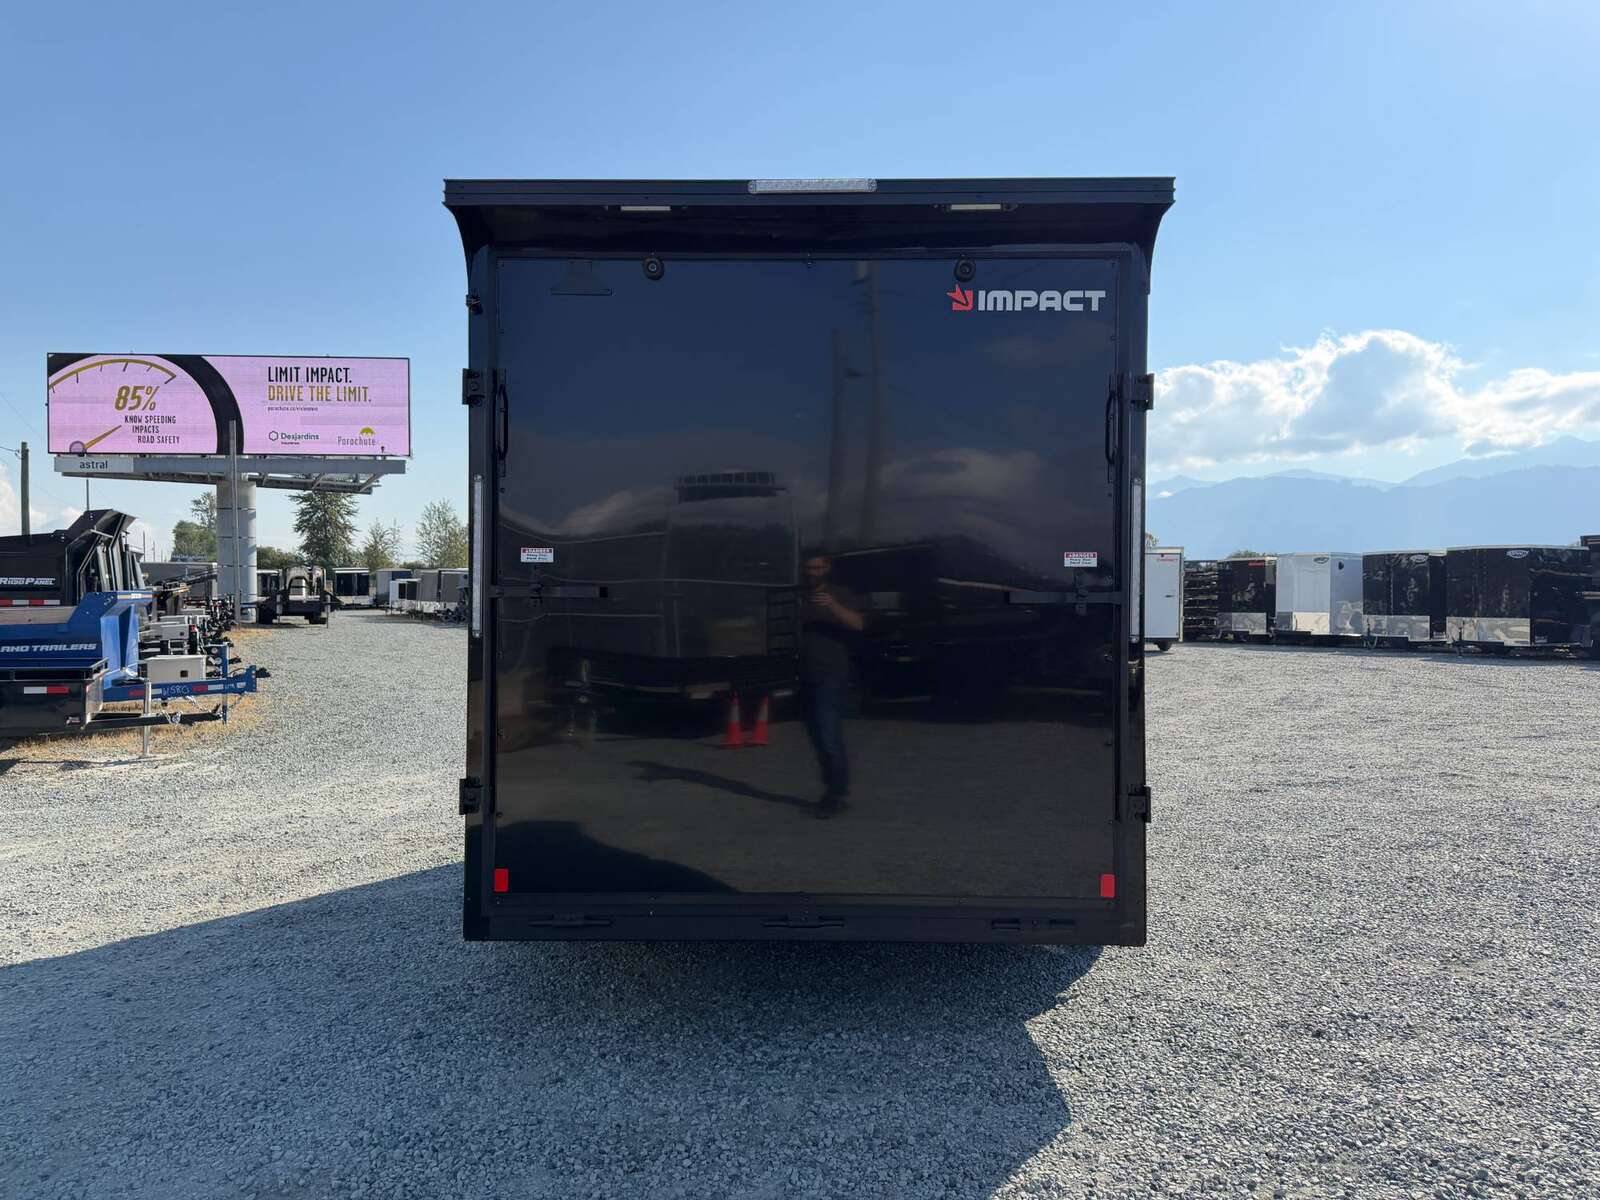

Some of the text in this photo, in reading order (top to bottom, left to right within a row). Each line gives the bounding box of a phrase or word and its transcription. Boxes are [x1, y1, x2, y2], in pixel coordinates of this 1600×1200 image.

[978, 290, 1106, 312] IMPACT
[268, 366, 352, 384] LIMIT IMPACT.
[114, 385, 160, 411] 85%
[268, 385, 372, 403] DRIVE THE LIMIT.
[124, 415, 176, 424] KNOW SPEEDING
[132, 425, 160, 434] IMPACTS
[137, 435, 180, 444] ROAD SAFETY
[280, 432, 320, 441] Desjardins
[79, 460, 108, 469] astral
[31, 643, 97, 652] TRAILERS
